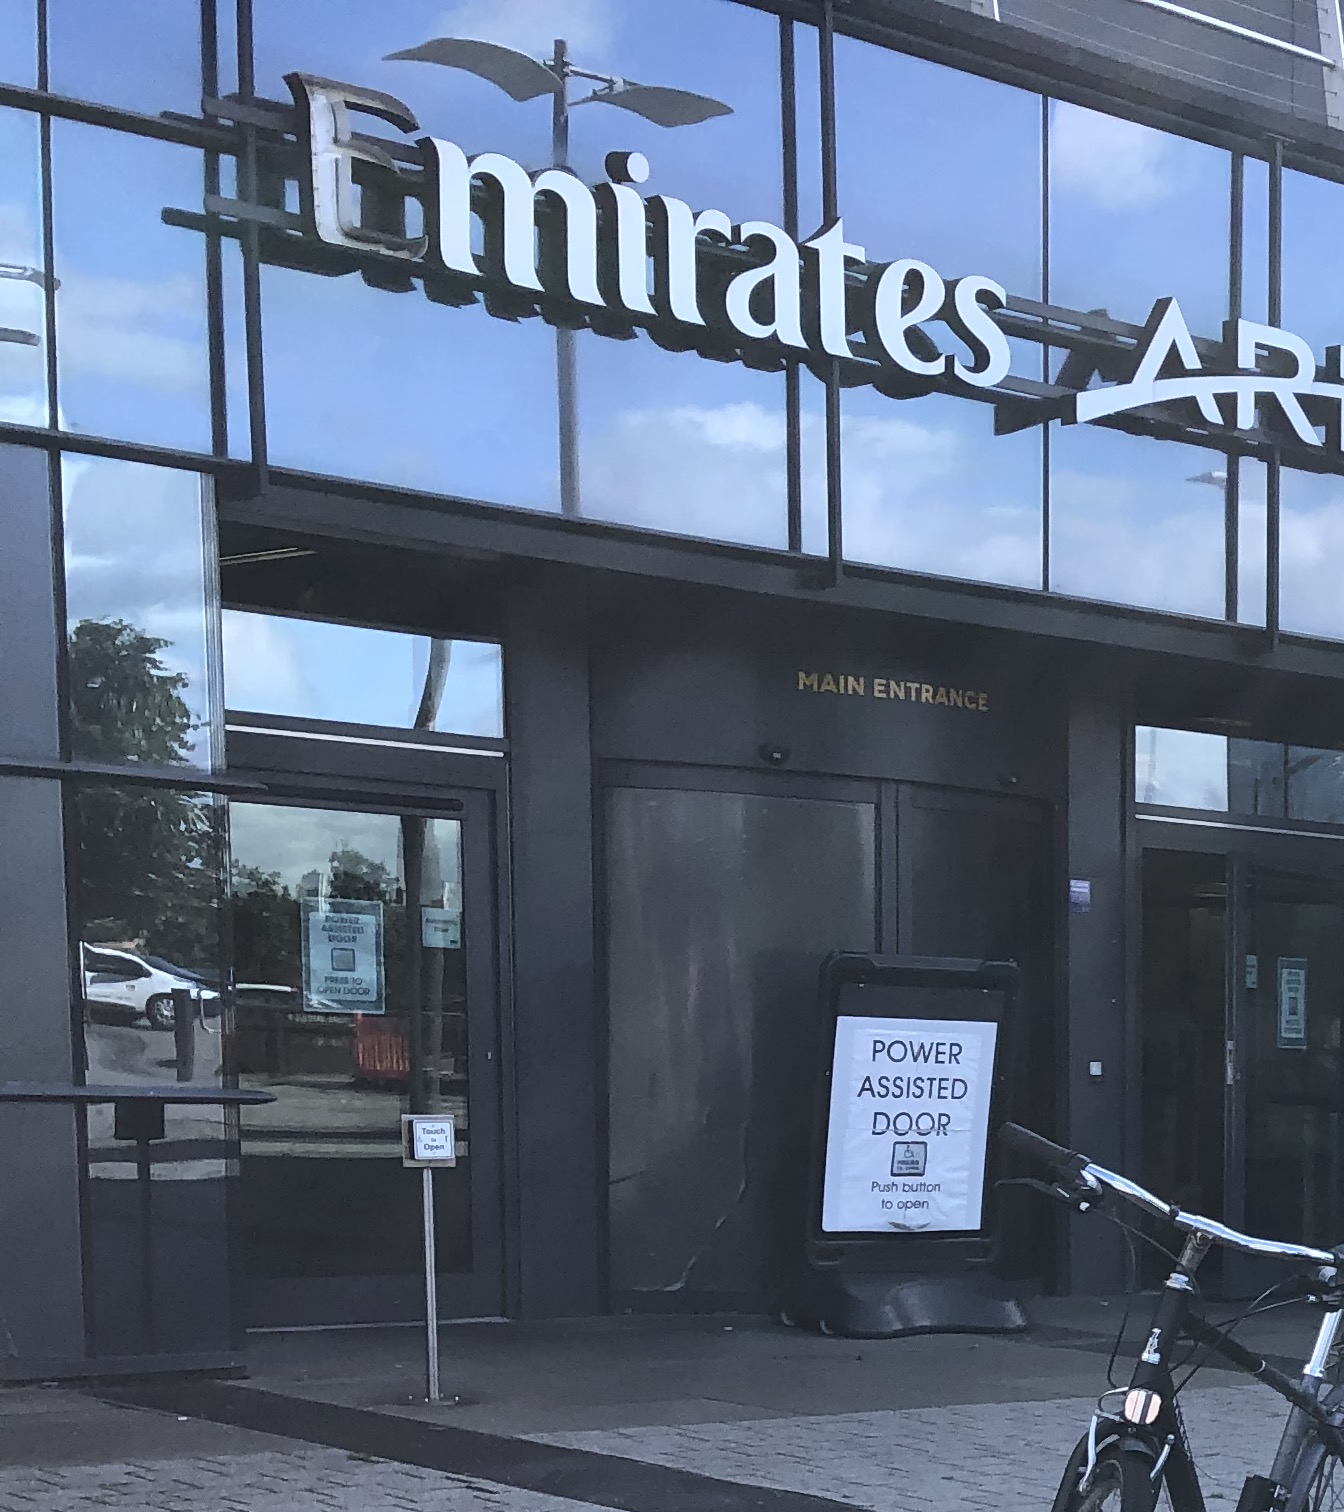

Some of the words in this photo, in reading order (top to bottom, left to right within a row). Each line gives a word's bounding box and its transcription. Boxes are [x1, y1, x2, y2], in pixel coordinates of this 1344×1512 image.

[283, 70, 1010, 387] Emirates
[798, 671, 865, 696] MAIN
[873, 678, 990, 712] ENTRANCE
[343, 986, 371, 996] DOOR
[872, 1039, 964, 1065] POWER
[856, 1075, 968, 1100] ASSISTED
[871, 1111, 951, 1137] DOOR
[871, 1181, 898, 1193] Push
[902, 1181, 941, 1193] button
[881, 1199, 893, 1210] to
[896, 1200, 929, 1212] open
